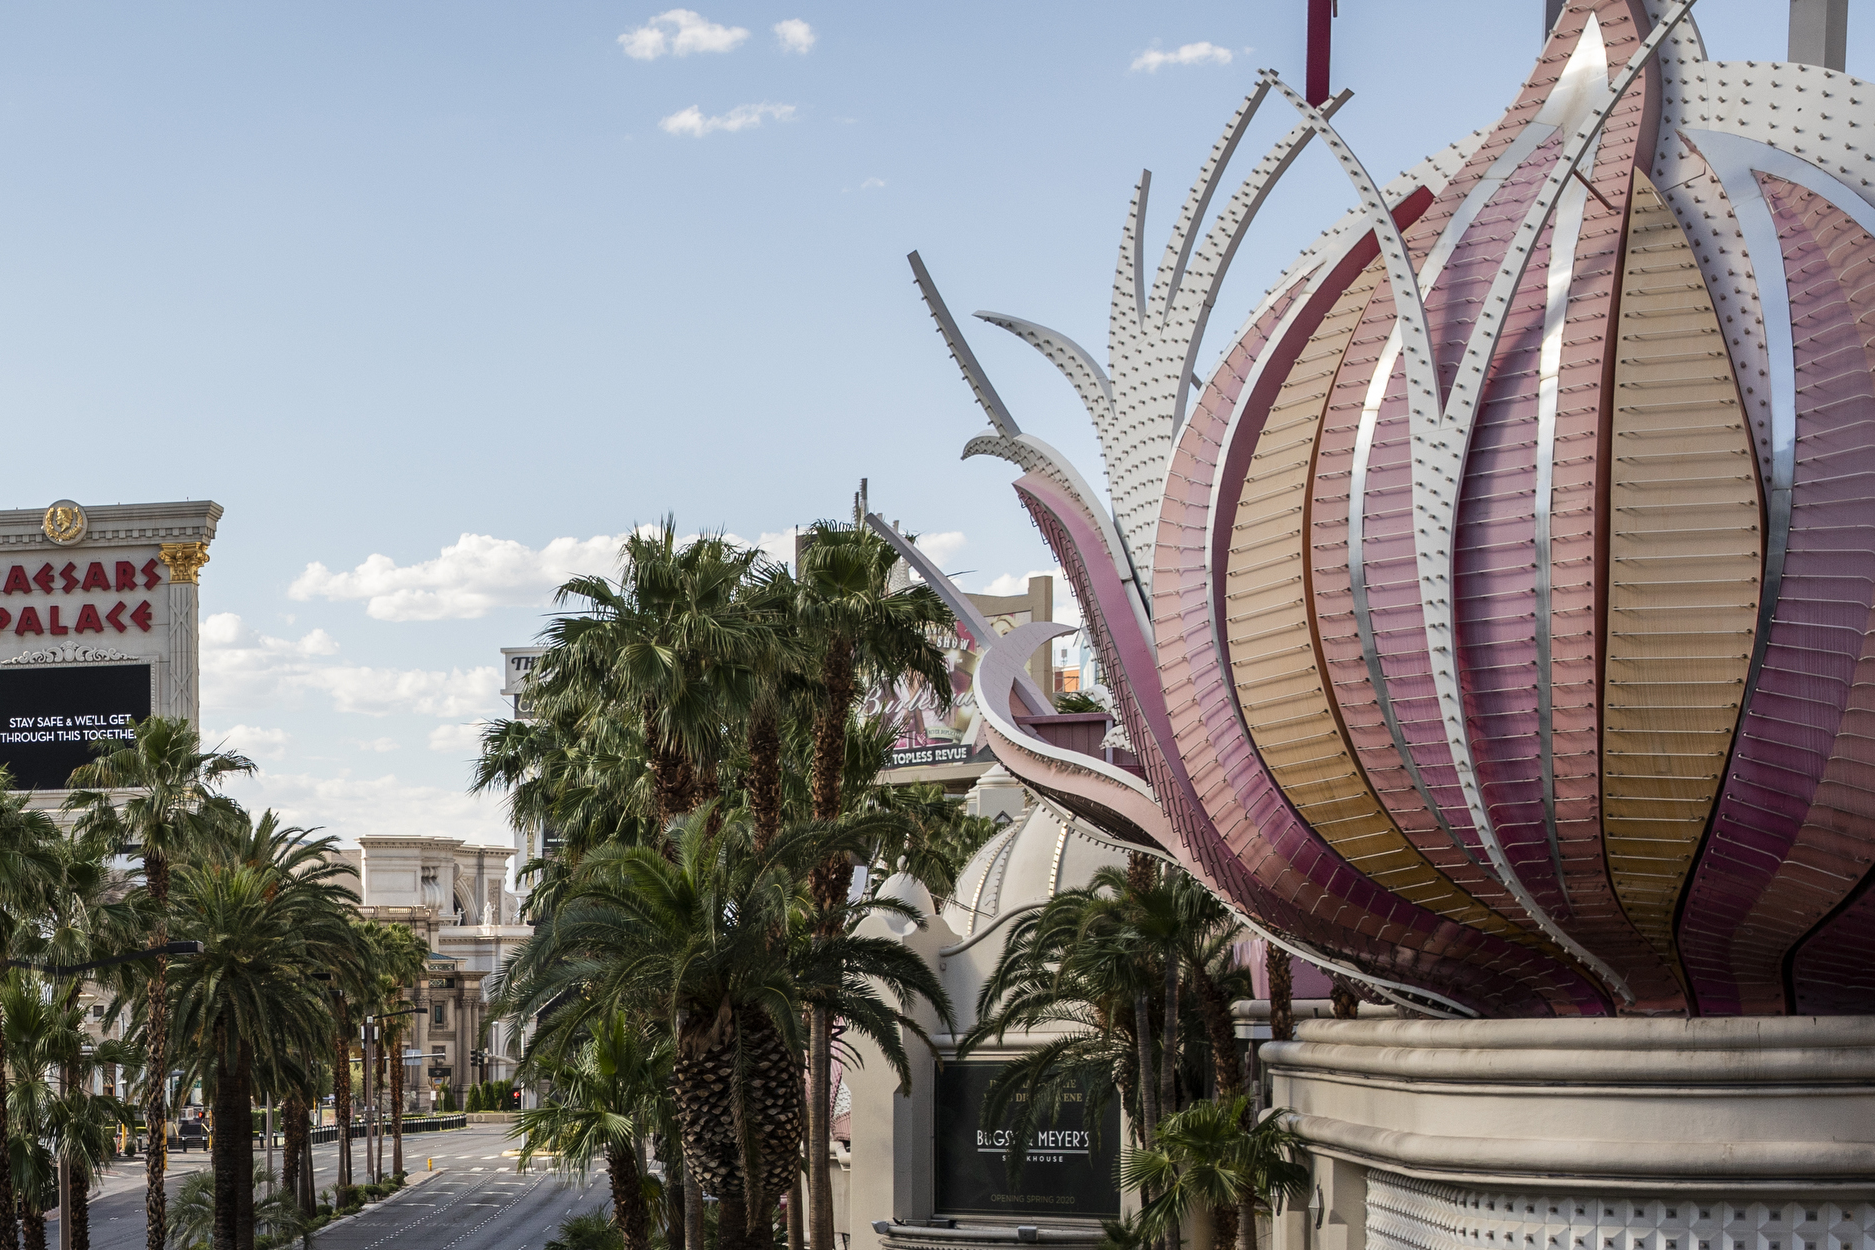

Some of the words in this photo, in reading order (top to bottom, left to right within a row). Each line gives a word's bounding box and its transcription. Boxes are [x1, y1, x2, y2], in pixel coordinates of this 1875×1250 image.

[936, 636, 969, 650] SHOW
[859, 686, 977, 718] Burlesu
[9, 717, 35, 728] STAY
[37, 716, 63, 727] SAFE
[66, 718, 72, 727] &
[75, 715, 106, 726] WE'LL
[109, 714, 131, 725] GET
[0, 732, 54, 743] THROUGH
[57, 731, 80, 741] THIS
[83, 729, 137, 741] TOGETHE
[892, 750, 932, 765] TOPLESS
[935, 748, 966, 761] REVUE
[1038, 1130, 1089, 1147] MEYER'S
[1002, 1155, 1063, 1163] SKHOUSE
[991, 1193, 1025, 1203] OPENING
[1026, 1195, 1054, 1204] SPRING
[1056, 1196, 1075, 1205] 2020
